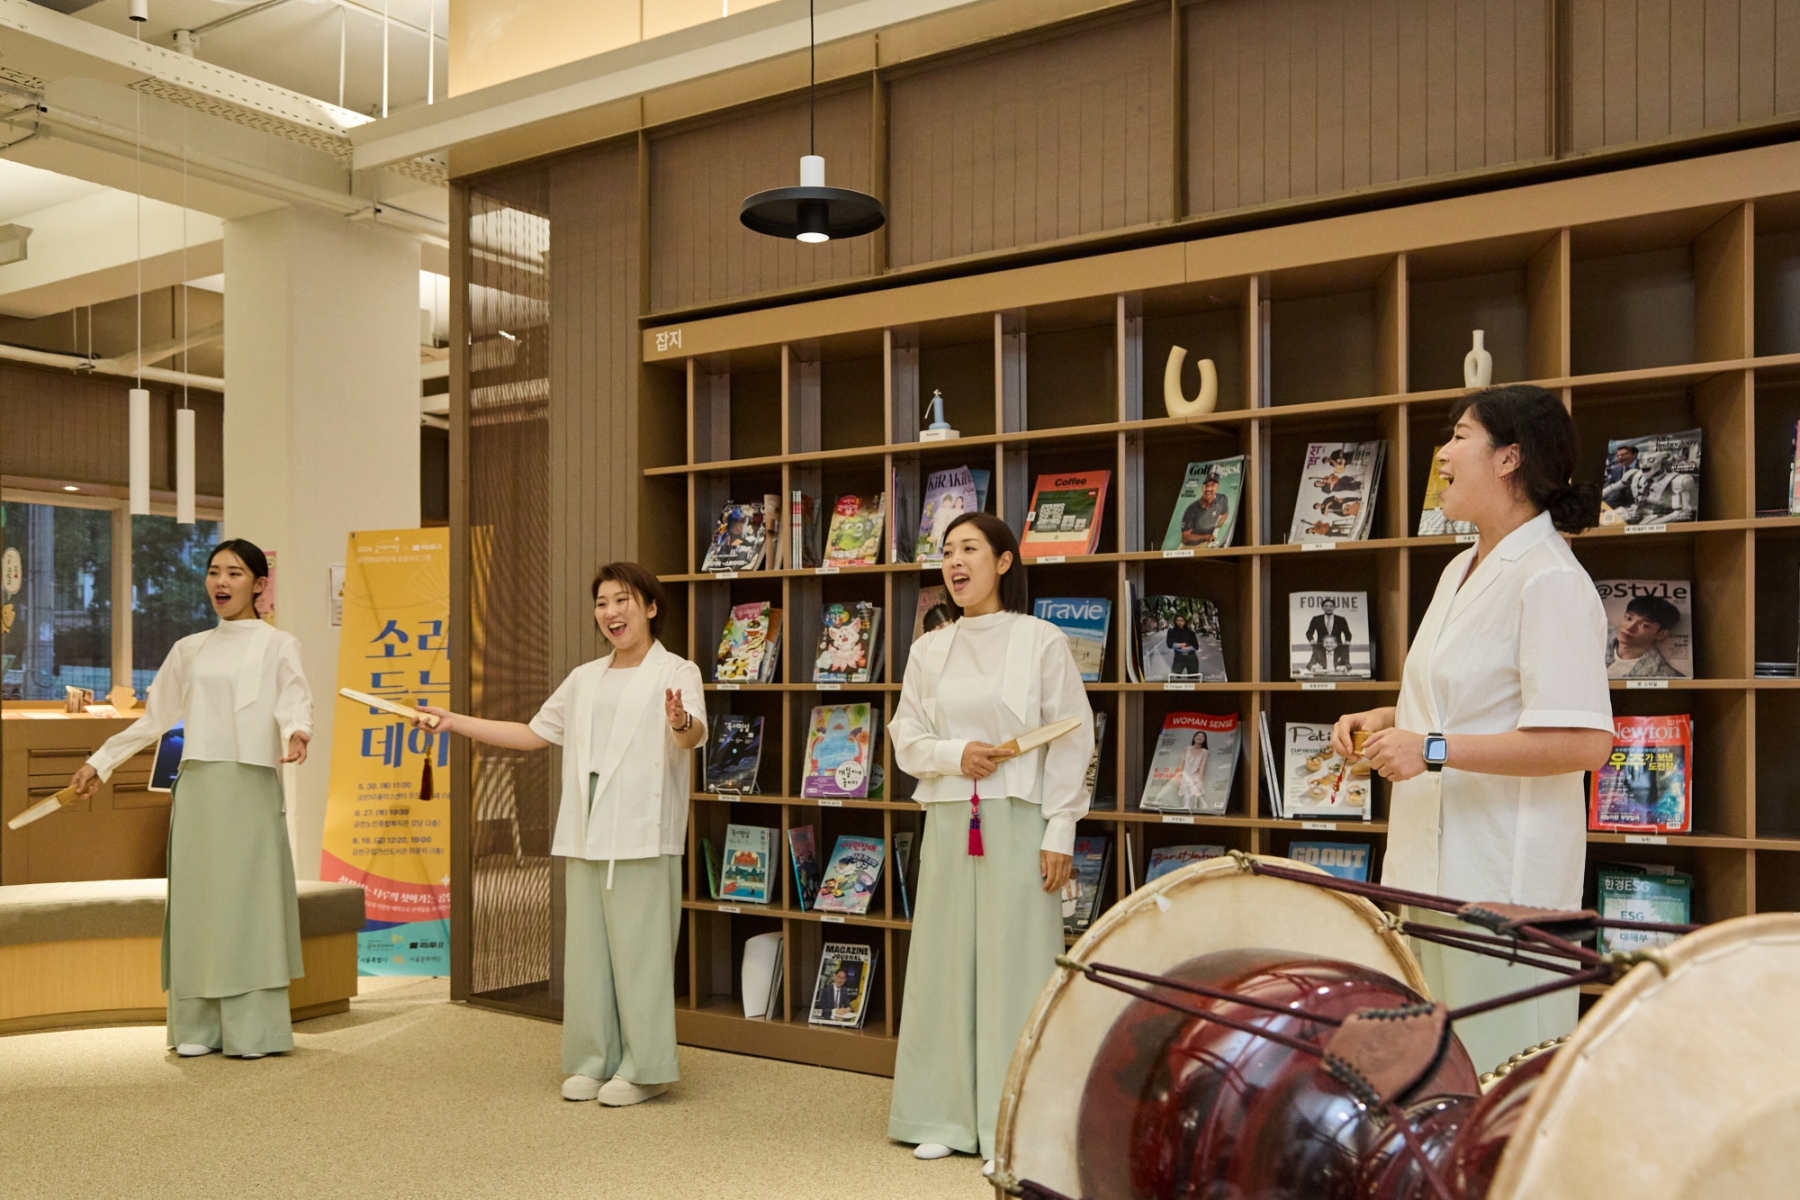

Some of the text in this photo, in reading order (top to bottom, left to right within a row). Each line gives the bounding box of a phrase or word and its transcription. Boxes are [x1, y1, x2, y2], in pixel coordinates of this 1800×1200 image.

[655, 329, 682, 352] 잡지
[1189, 463, 1240, 478] Golf Digest
[1054, 478, 1087, 486] Coffee
[1596, 583, 1688, 599] @Style
[1300, 596, 1358, 608] FORUNE
[1038, 600, 1104, 620] Travie
[365, 620, 450, 660] 소리
[1172, 717, 1233, 728] WOMAN SENSE
[1288, 726, 1332, 743] Pâti
[361, 722, 450, 768] 데이
[1609, 752, 1673, 771] 우주가 보낸
[1649, 762, 1674, 771] 도전장
[840, 841, 878, 852] 시사원정대
[1292, 847, 1365, 868] GO OUT
[1605, 878, 1650, 892] 한경ESG
[373, 888, 399, 902] 타루의
[400, 892, 435, 904] 찾아가는
[1620, 910, 1644, 921] ESG
[1620, 932, 1648, 942] 대해부
[826, 945, 868, 955] MAGAZINE
